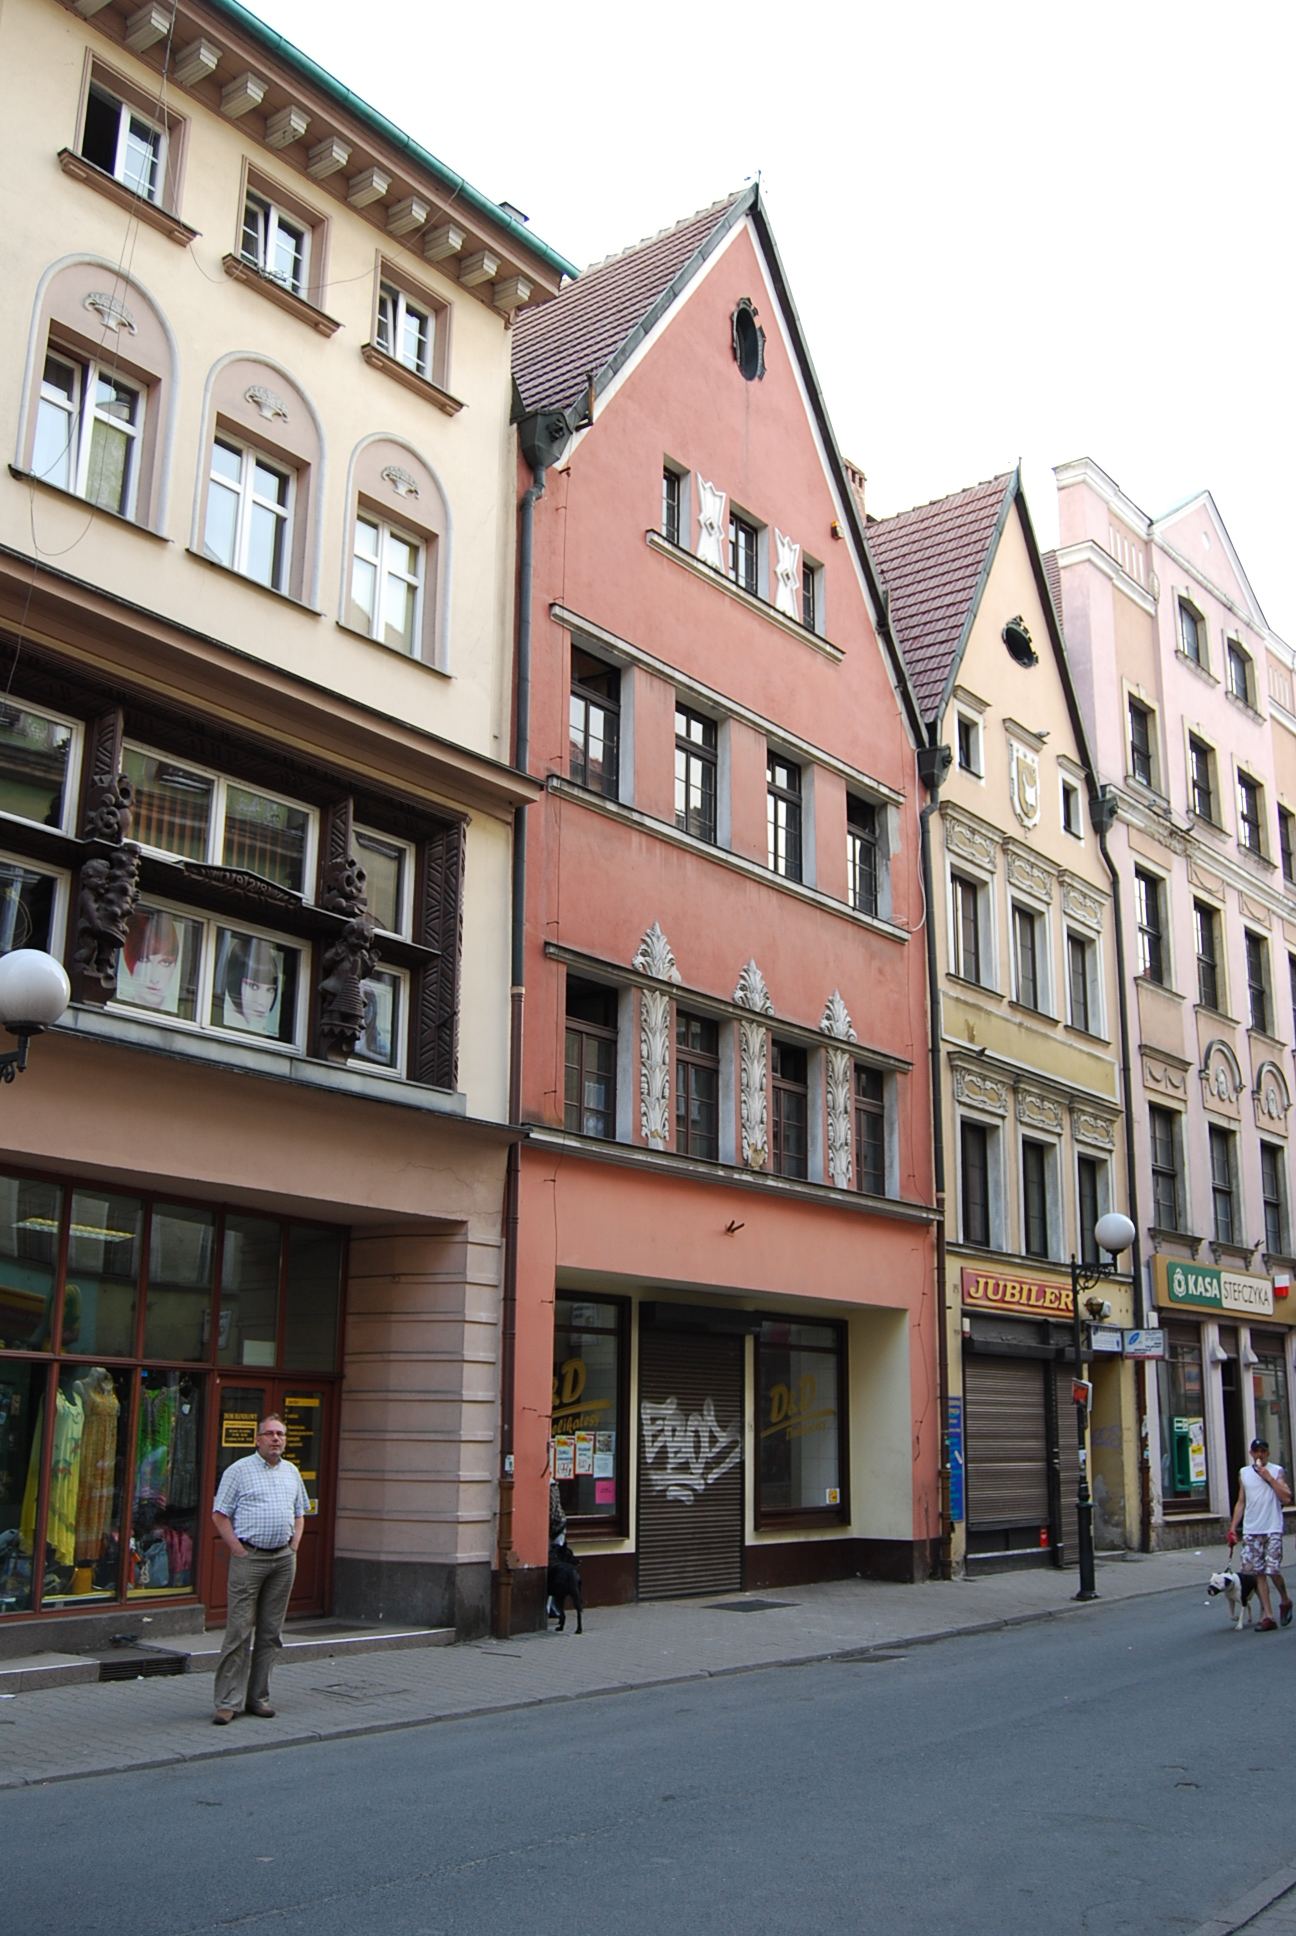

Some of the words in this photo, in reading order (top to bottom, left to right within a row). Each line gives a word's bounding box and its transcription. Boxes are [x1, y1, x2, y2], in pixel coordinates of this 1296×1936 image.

[969, 1277, 1074, 1310] JUBILER
[1187, 1273, 1220, 1299] KASA
[1223, 1280, 1271, 1306] STEFCZYKA
